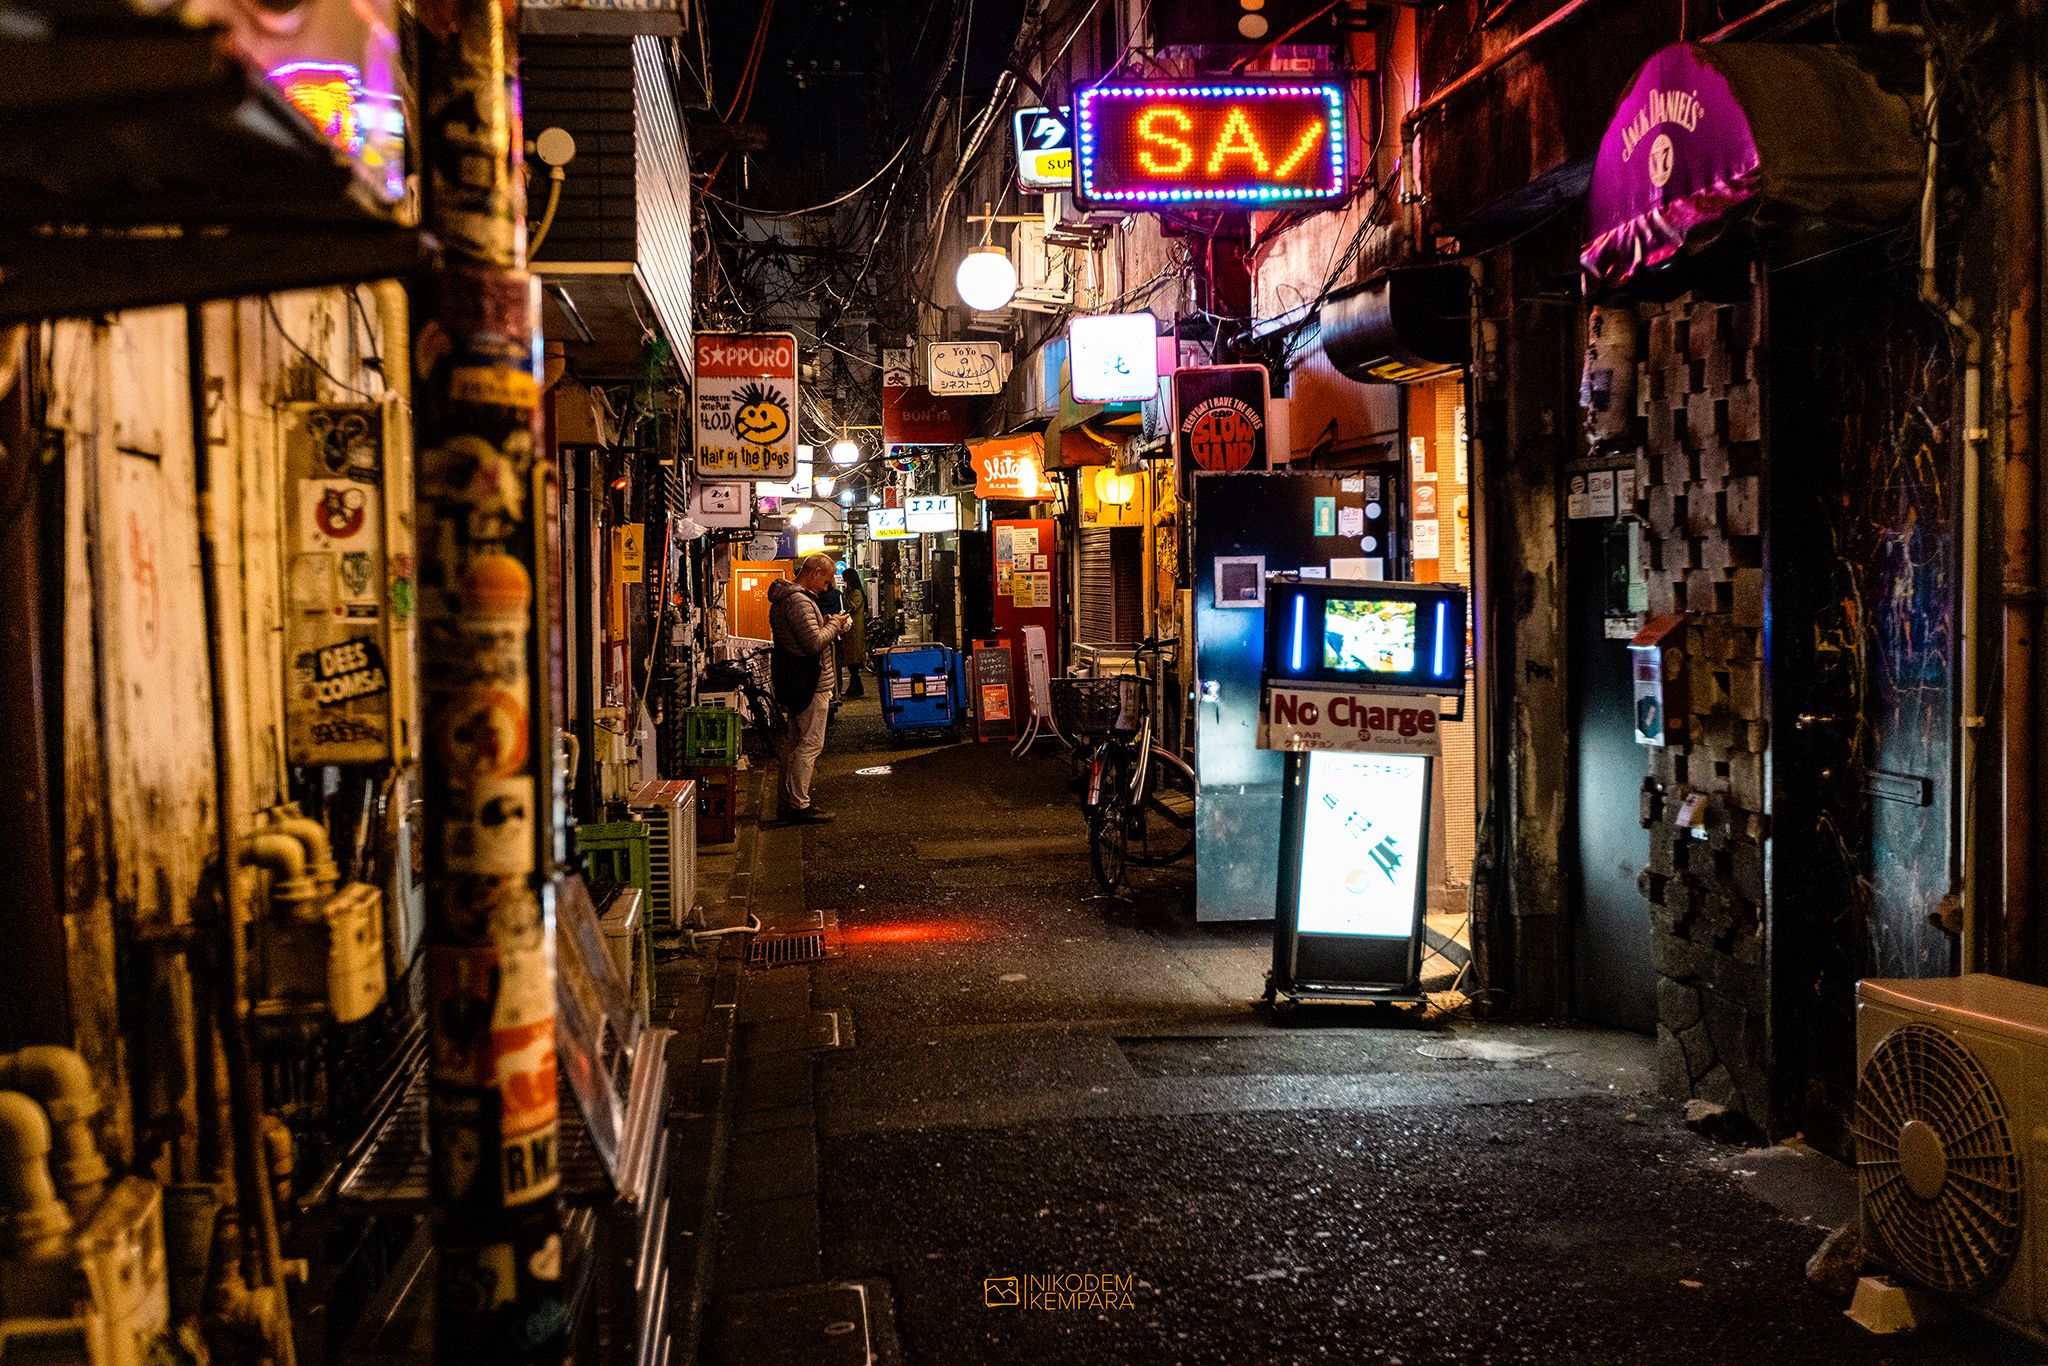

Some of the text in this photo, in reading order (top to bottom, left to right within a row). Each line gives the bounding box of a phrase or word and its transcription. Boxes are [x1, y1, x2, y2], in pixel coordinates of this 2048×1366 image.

[941, 380, 990, 389] シネストーク
[1193, 410, 1254, 443] SLOW
[1213, 397, 1233, 407] HAVE
[1233, 398, 1248, 413] THE
[1244, 407, 1264, 431] BLUES
[700, 446, 789, 469] Hair of the Dogs
[1193, 442, 1253, 471] HAND
[1275, 694, 1437, 737] No Charge
